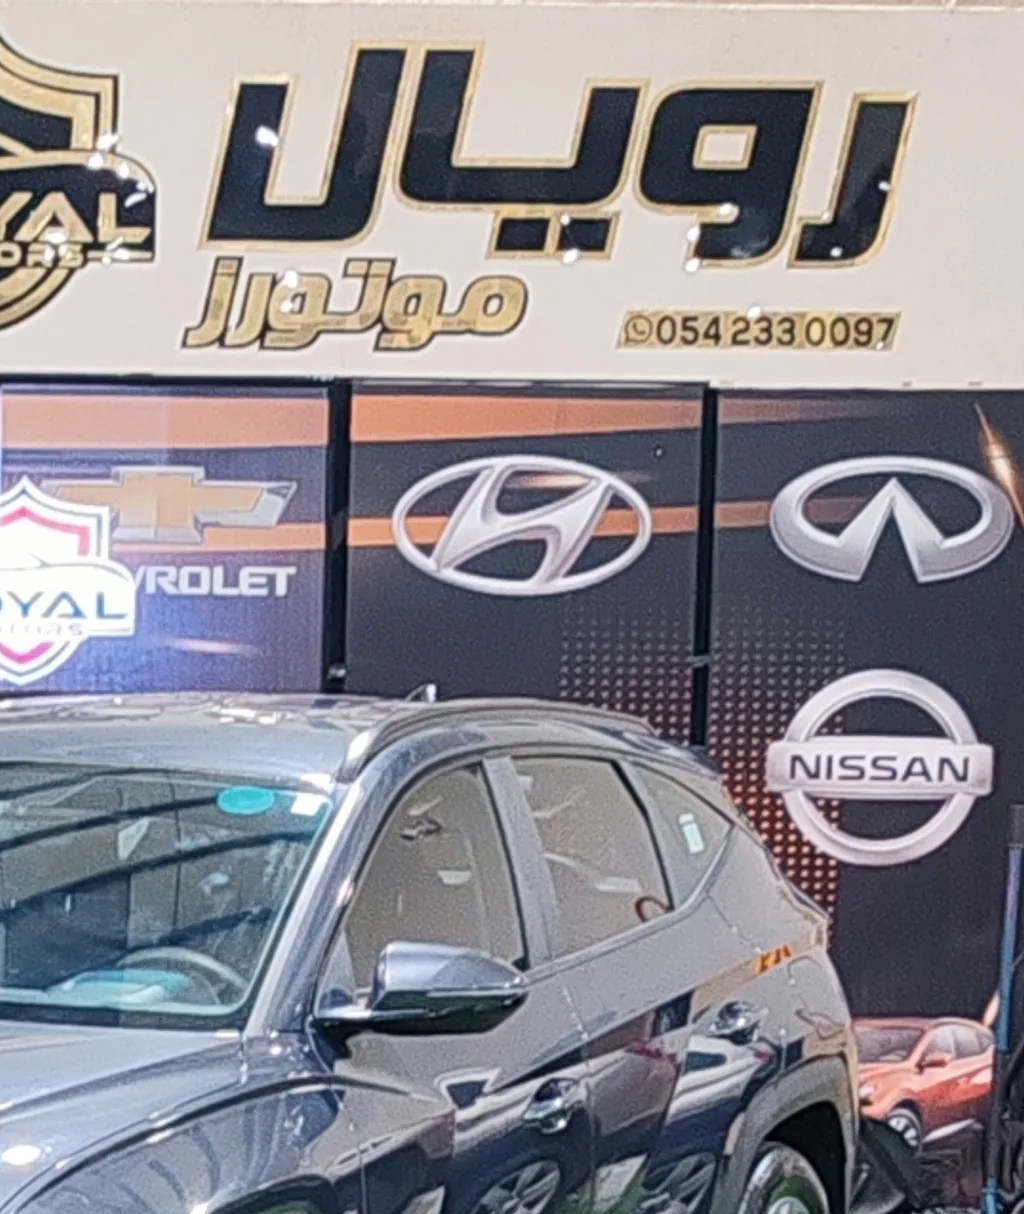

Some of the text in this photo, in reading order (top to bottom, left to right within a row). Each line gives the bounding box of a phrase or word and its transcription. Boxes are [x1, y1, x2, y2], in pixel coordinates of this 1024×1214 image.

[199, 40, 919, 268] رويال
[182, 256, 528, 351] موتورز
[656, 314, 721, 346] 054
[731, 315, 795, 346] 233
[789, 754, 970, 783] NISSAN
